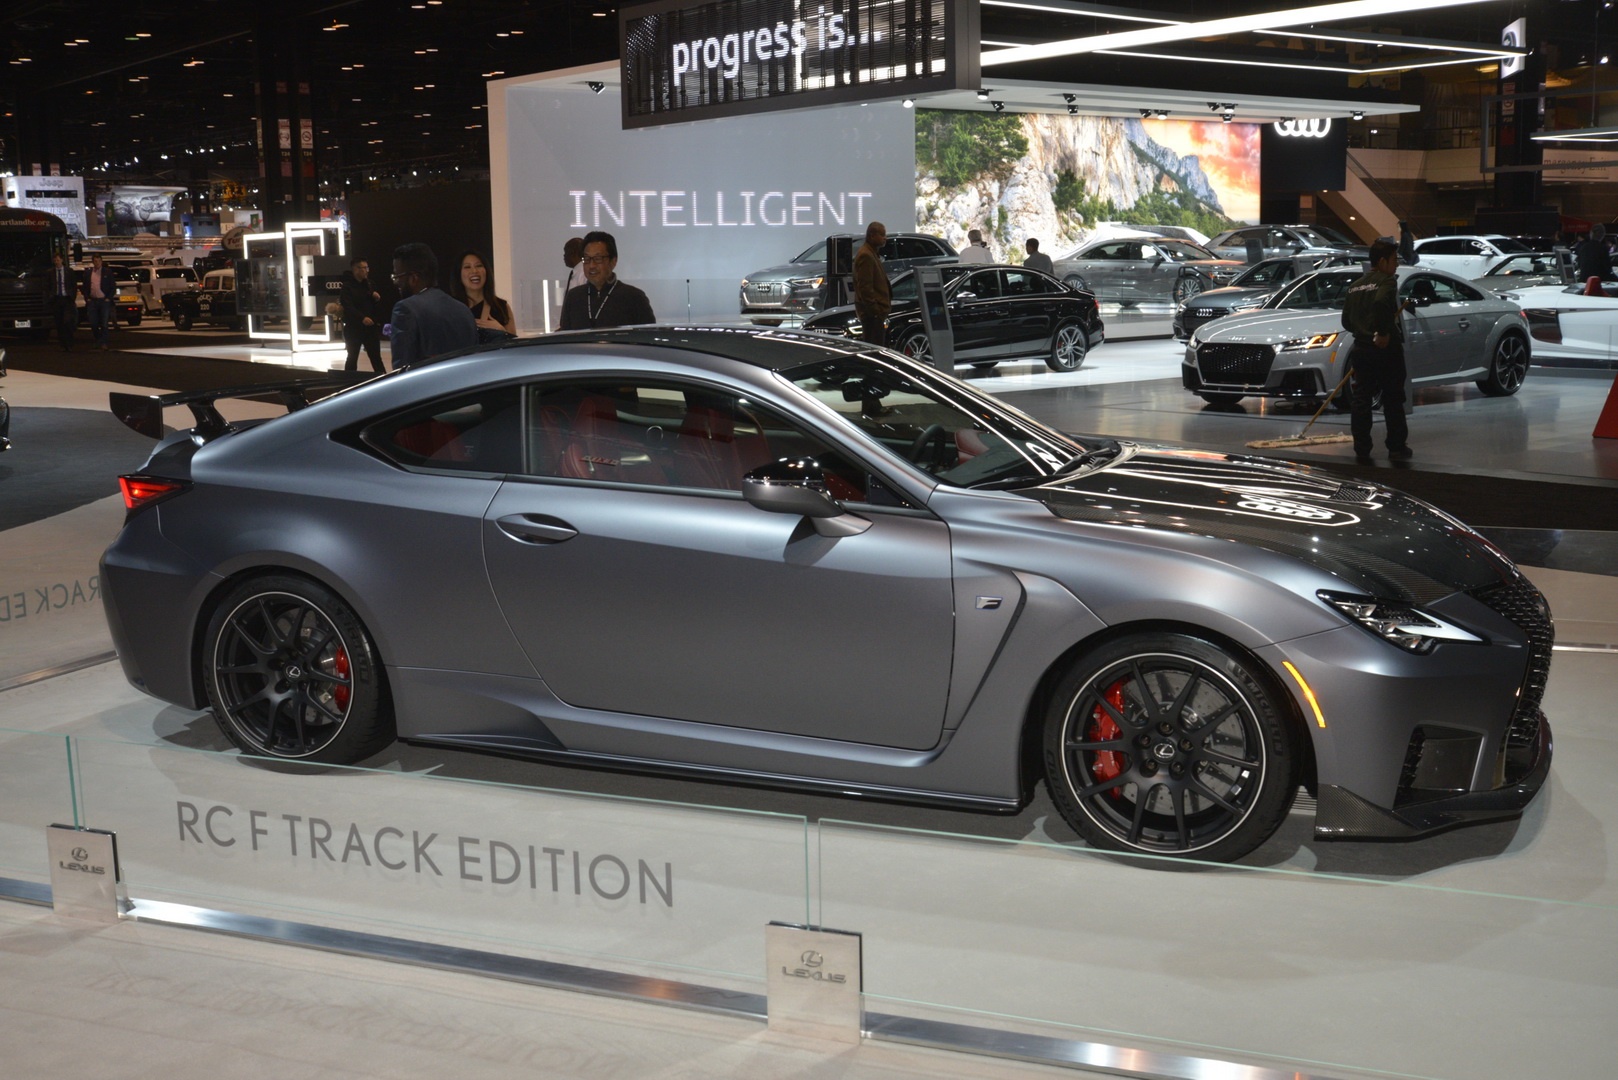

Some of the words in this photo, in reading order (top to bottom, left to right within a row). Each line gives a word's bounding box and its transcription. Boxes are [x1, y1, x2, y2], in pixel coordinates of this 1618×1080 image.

[672, 19, 807, 87] progress
[39, 178, 64, 188] Jeep
[569, 190, 873, 228] INTELLIGENT
[1246, 680, 1284, 752] MICHELIN
[59, 860, 105, 875] LEXUS
[176, 800, 237, 848] RC
[249, 810, 268, 851] F
[281, 814, 443, 876] TRACK
[458, 836, 674, 908] EDITION
[782, 966, 847, 984] LEXUS
